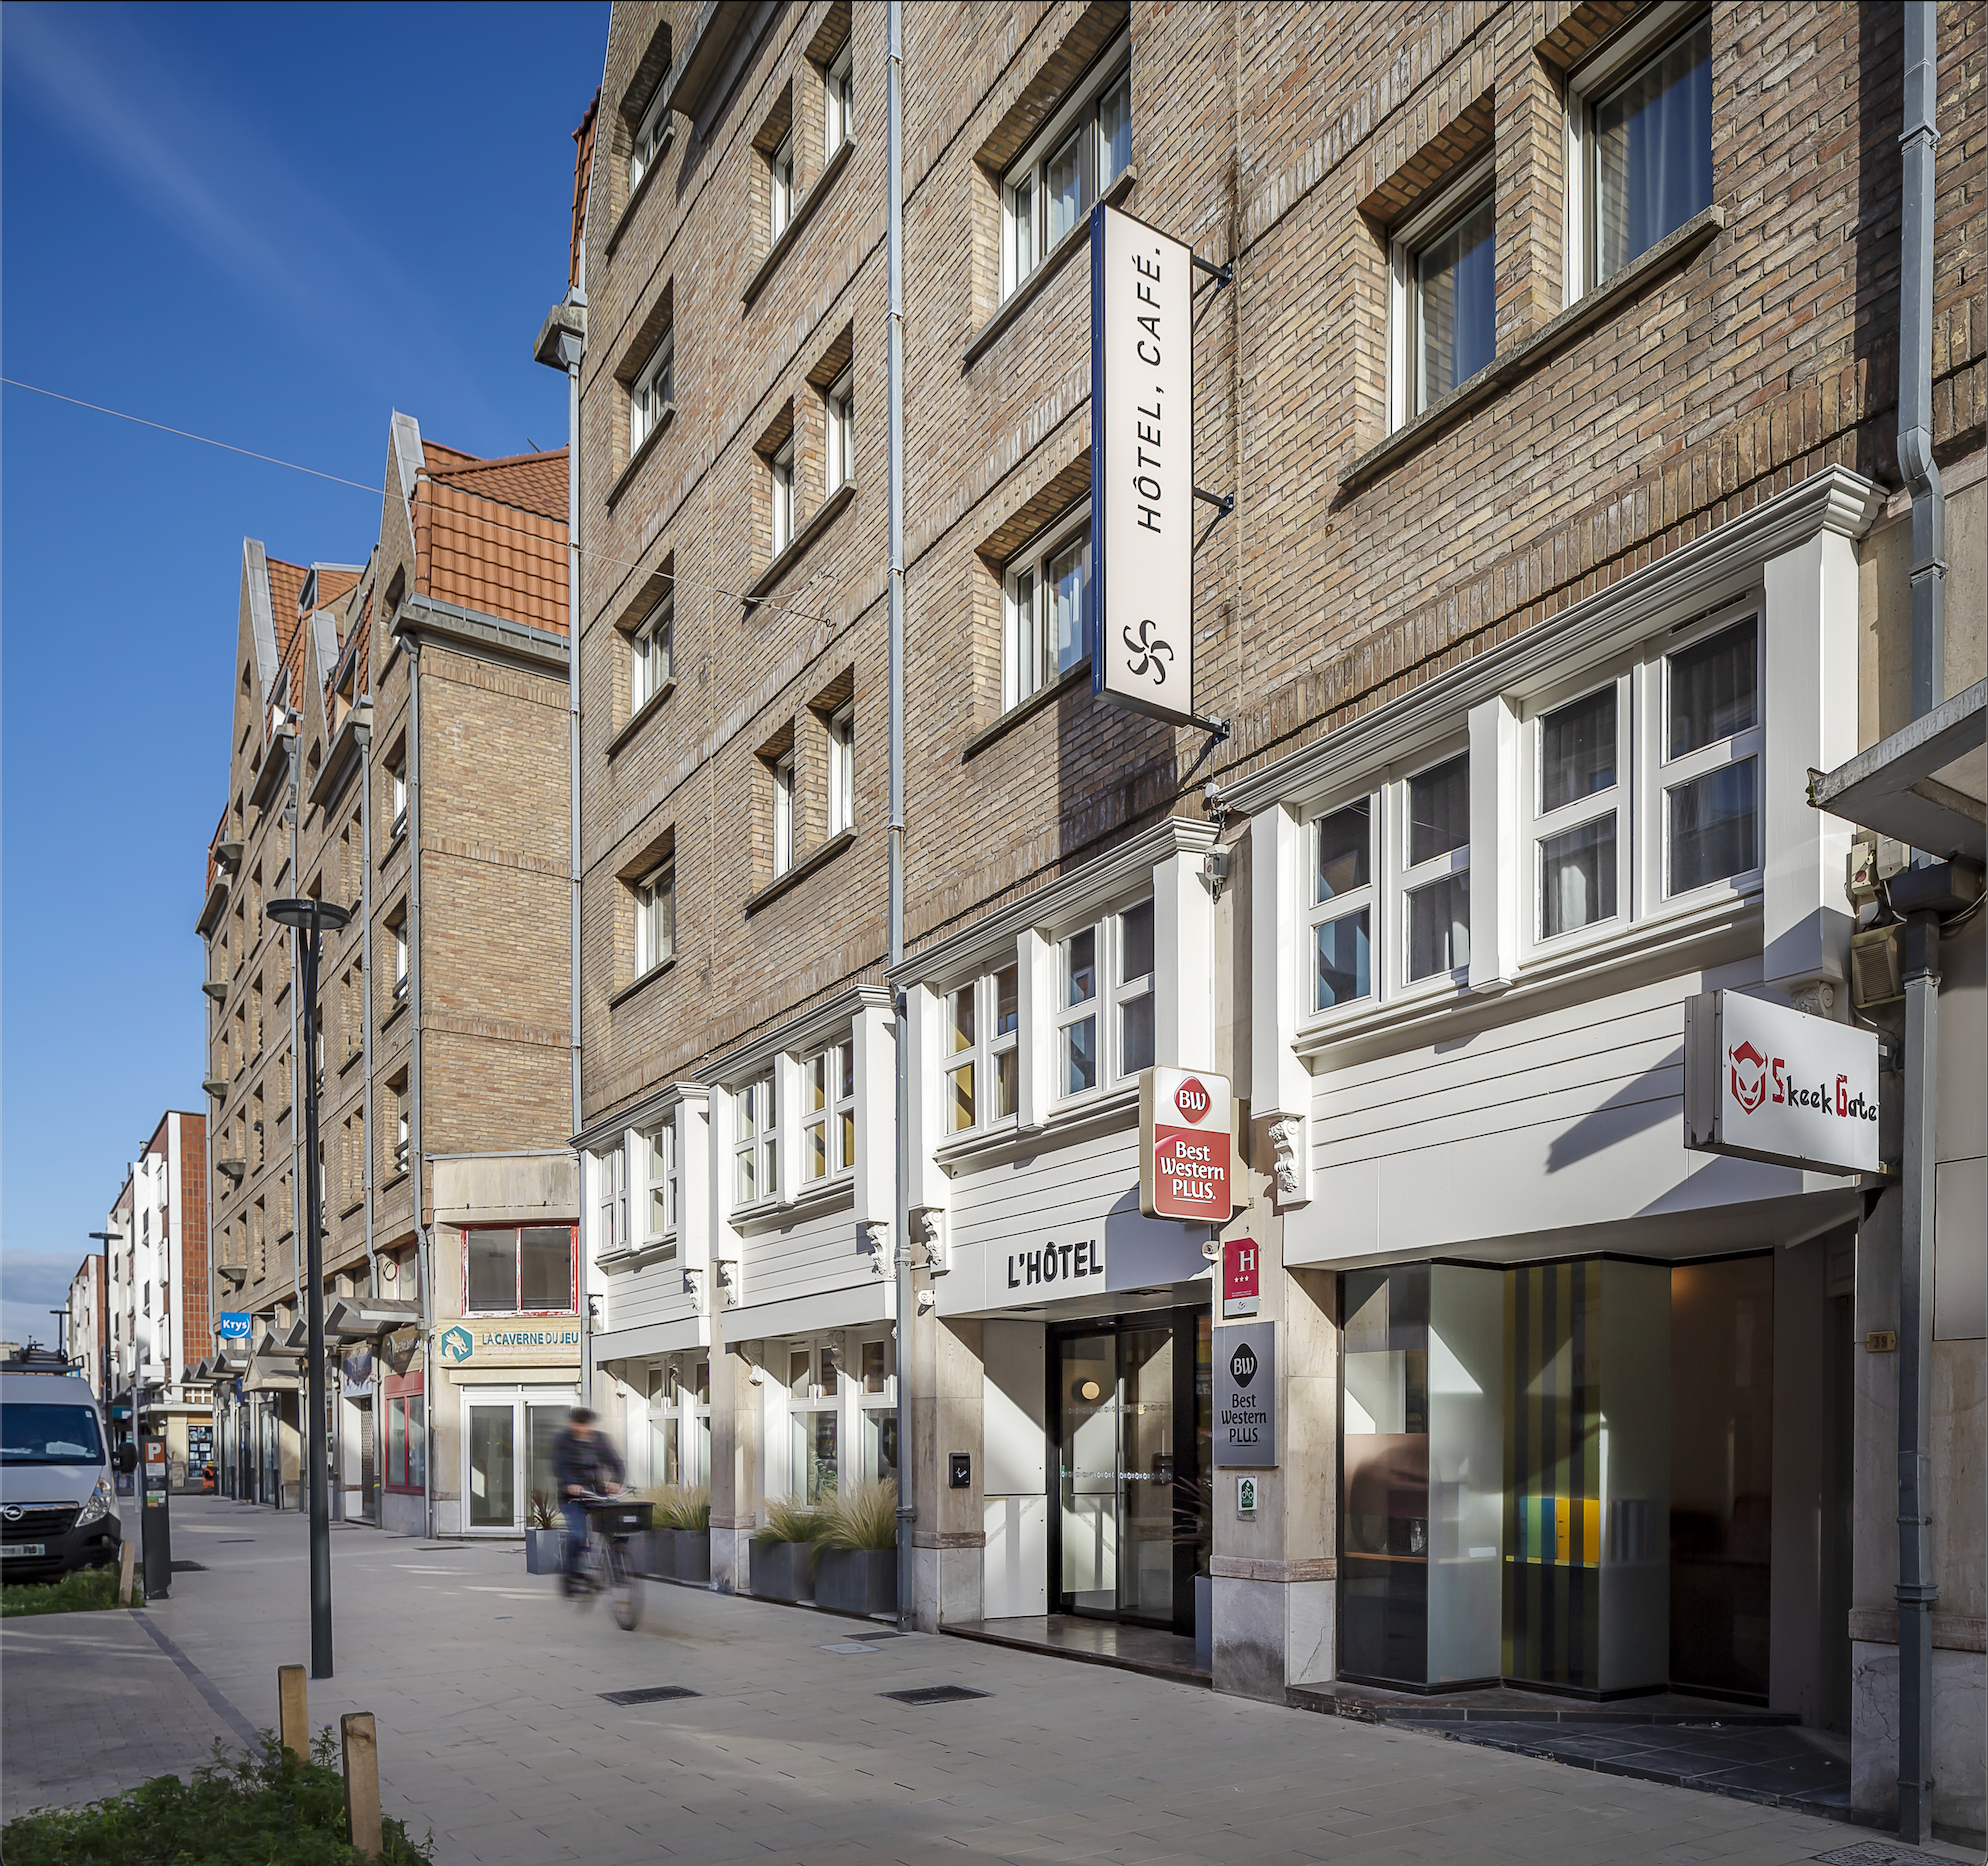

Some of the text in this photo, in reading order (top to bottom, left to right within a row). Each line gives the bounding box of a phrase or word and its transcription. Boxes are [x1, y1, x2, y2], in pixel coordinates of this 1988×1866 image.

[1131, 247, 1165, 534] HÔTEL, CAFÉ.
[1179, 1089, 1207, 1111] BW
[1836, 1073, 1877, 1122] Gate
[1175, 1140, 1211, 1162] Best
[1160, 1156, 1225, 1181] Western
[1007, 1239, 1104, 1289] L'HÔTEL
[1239, 1248, 1256, 1273] H
[222, 1319, 248, 1332] Krys
[482, 1332, 579, 1345] LA CAVERNE DU JEU
[1873, 1335, 1888, 1348] 39
[1233, 1356, 1255, 1376] BW
[1231, 1393, 1257, 1409] Best
[1221, 1410, 1267, 1425] Western
[148, 1442, 162, 1460] P
